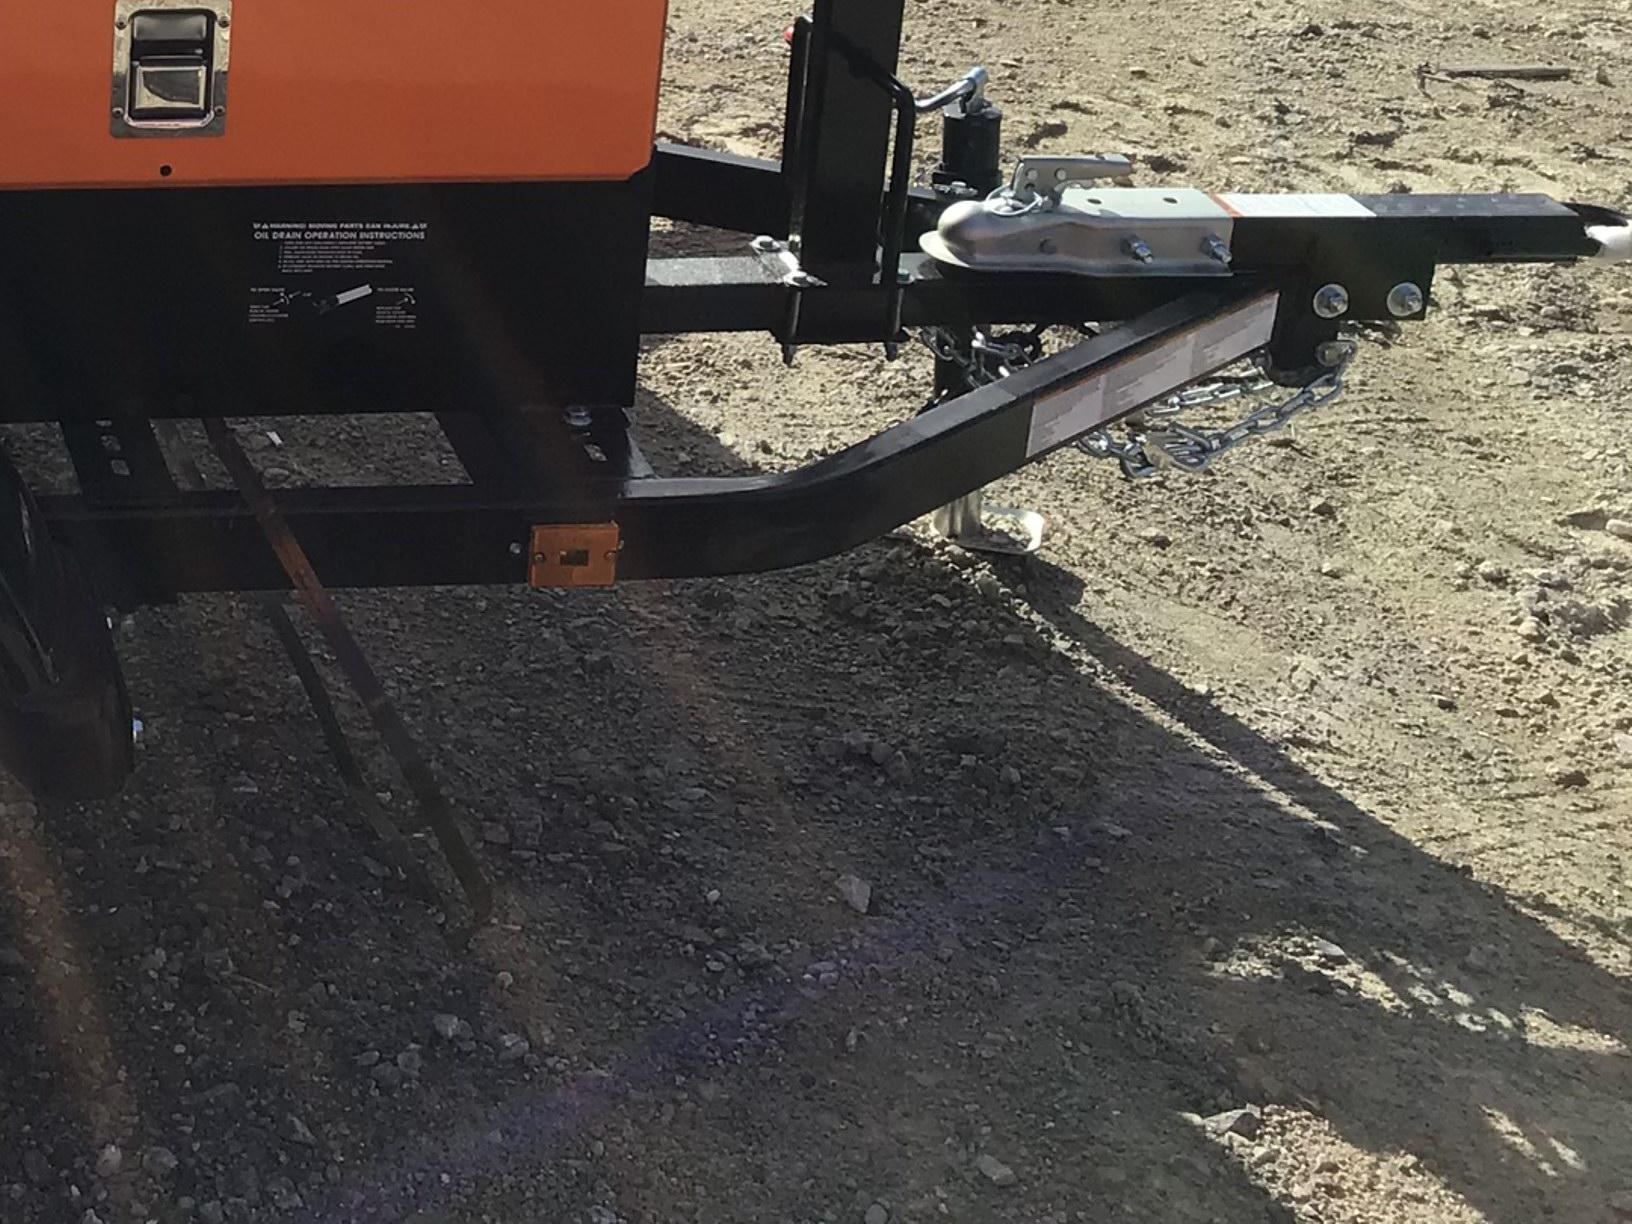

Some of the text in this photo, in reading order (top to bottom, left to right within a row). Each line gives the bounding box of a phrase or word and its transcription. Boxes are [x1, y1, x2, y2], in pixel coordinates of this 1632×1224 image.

[254, 232, 425, 240] OIL DRAIN OPERATION INSTRUCTIONS
